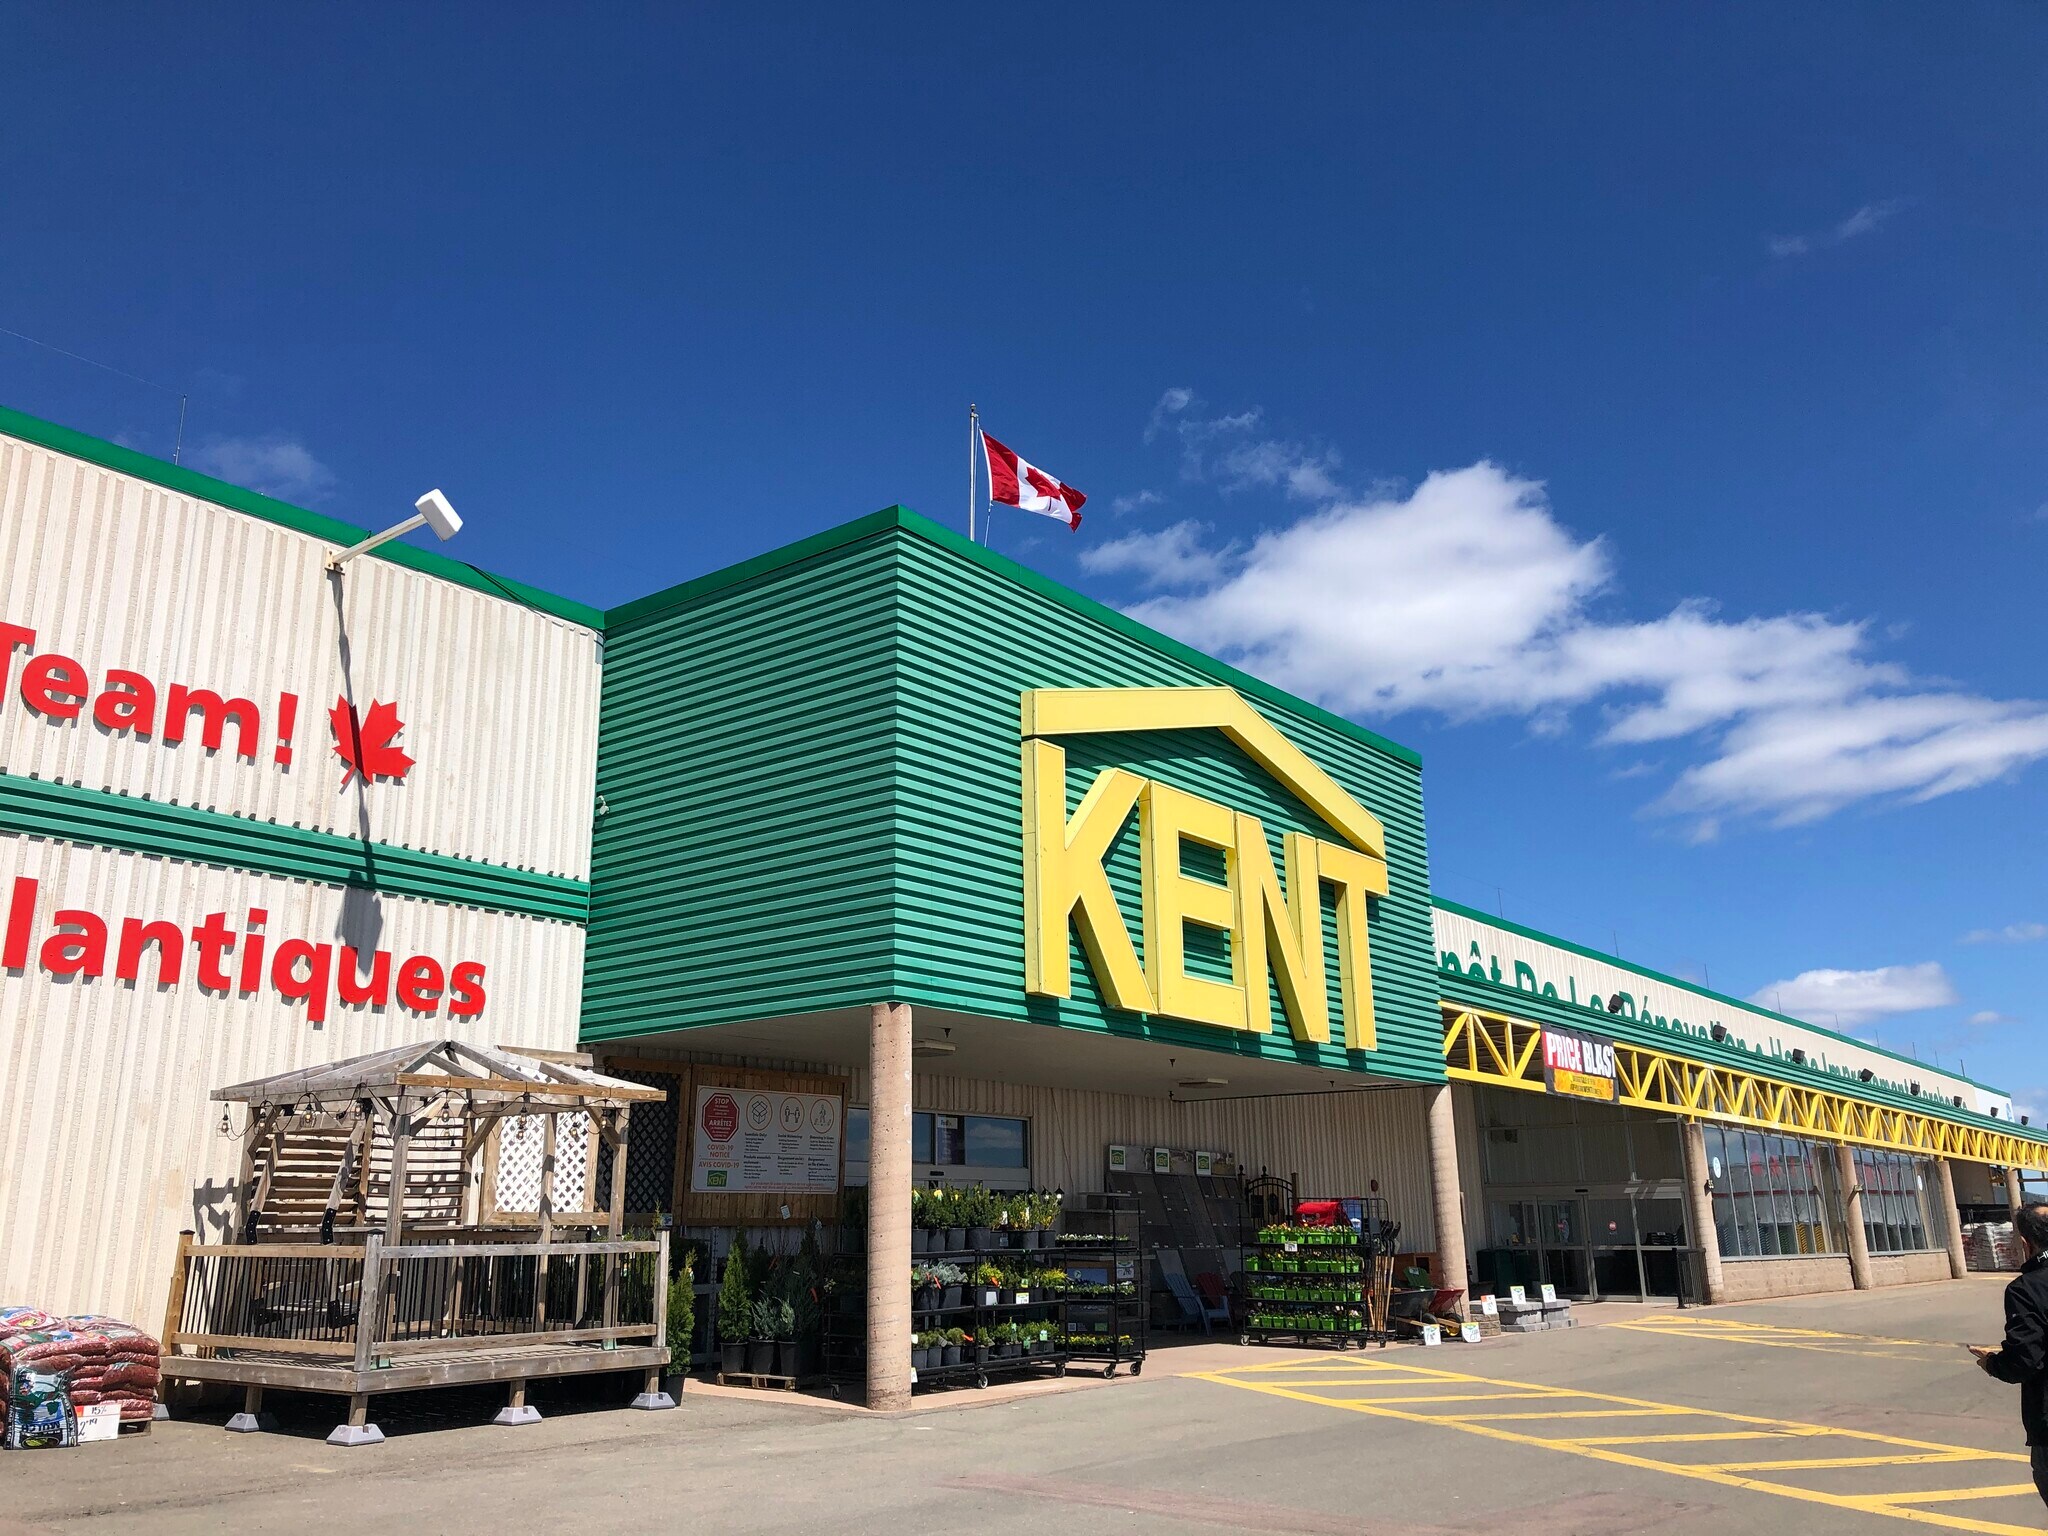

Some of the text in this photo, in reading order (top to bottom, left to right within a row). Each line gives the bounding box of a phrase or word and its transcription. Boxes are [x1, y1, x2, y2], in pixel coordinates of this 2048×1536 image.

[1021, 738, 1389, 1052] KENT
[2, 876, 487, 1023] lantiques
[1544, 1031, 1617, 1078] PRICE BLAST
[1618, 990, 1748, 1052] énovaton
[1769, 1036, 1818, 1070] Hoe
[1821, 1052, 1909, 1094] Imrement
[714, 1097, 730, 1105] STOP
[708, 1118, 733, 1127] ARRÊTEZ
[712, 1161, 740, 1169] COVID-19
[708, 1176, 726, 1186] KENT
